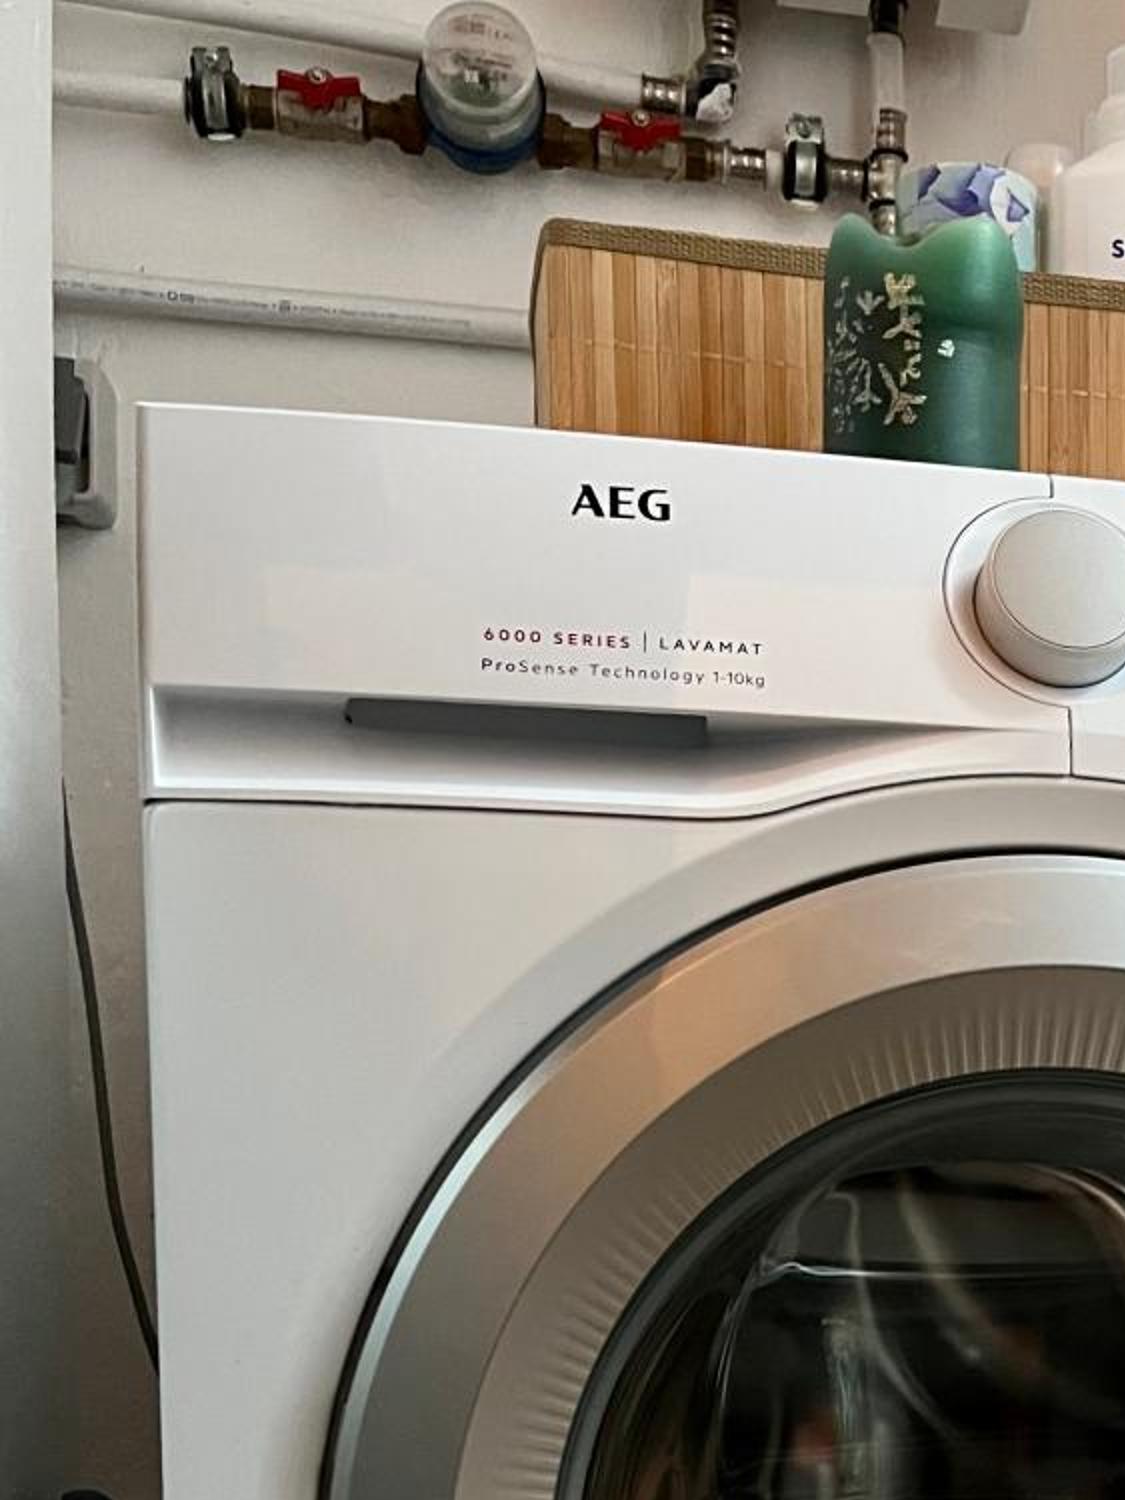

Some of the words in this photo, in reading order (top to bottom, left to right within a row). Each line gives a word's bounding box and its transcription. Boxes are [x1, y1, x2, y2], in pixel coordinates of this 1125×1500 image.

[571, 483, 671, 522] AEG
[482, 628, 542, 643] 6000
[553, 631, 631, 649] SERIES
[659, 636, 764, 655] LAVAMAT
[481, 657, 579, 675] ProSense
[590, 663, 705, 686] Technology
[713, 671, 766, 688] 1-10kg
